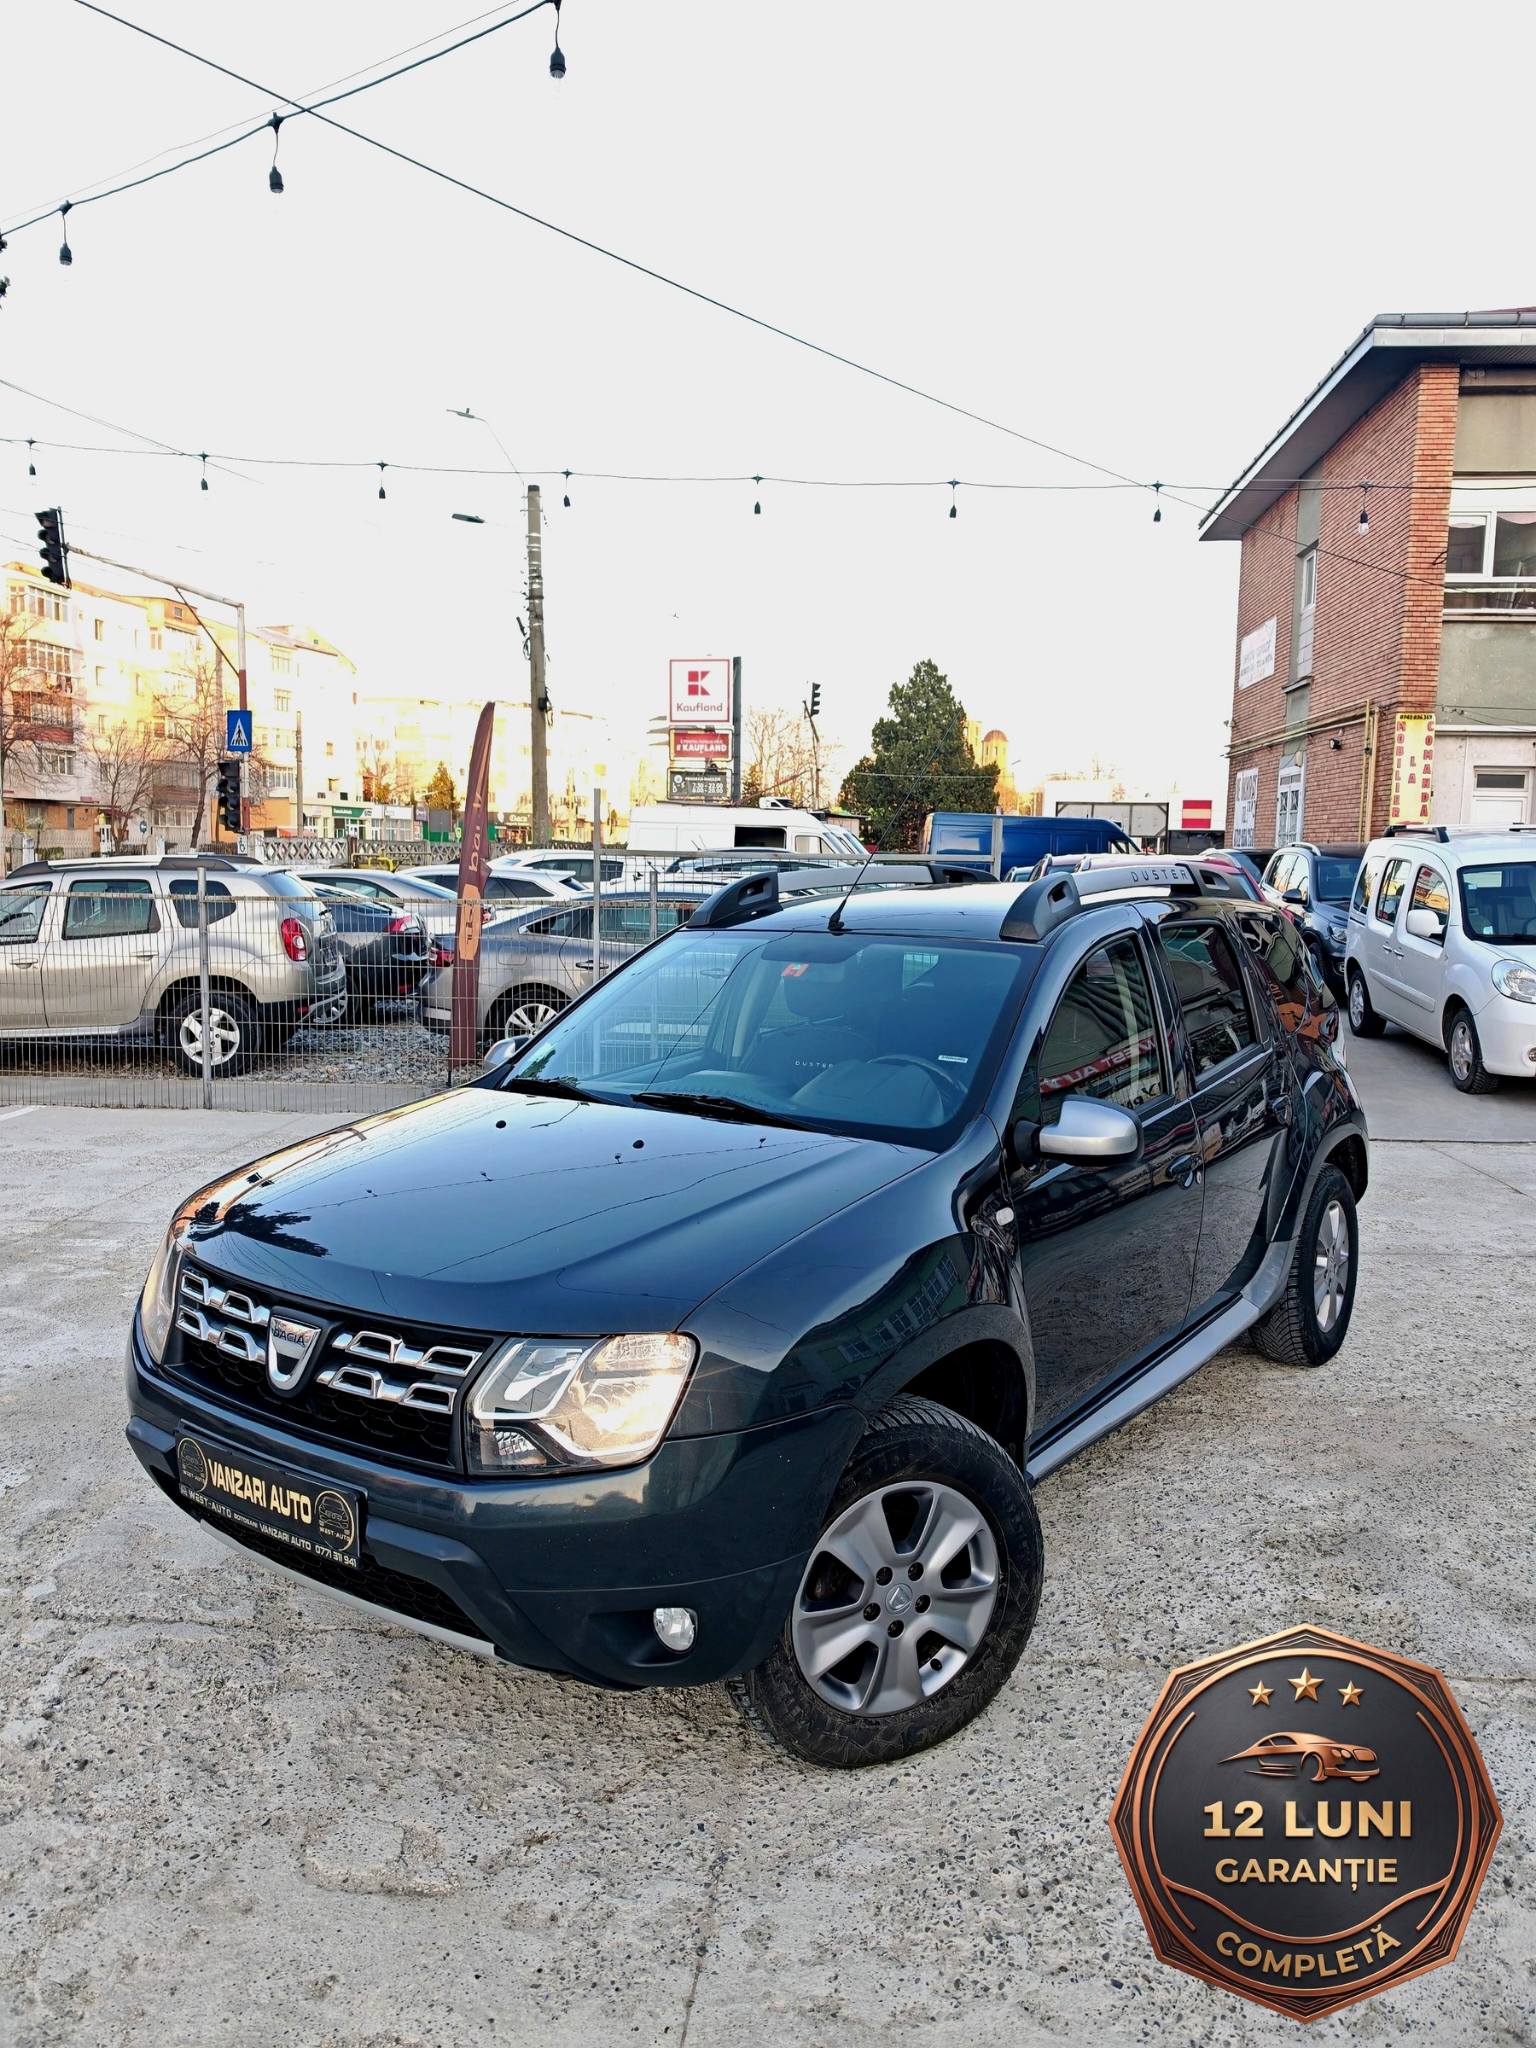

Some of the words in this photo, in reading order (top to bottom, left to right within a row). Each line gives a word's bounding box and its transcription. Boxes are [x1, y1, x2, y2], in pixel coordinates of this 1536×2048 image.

[676, 702, 723, 712] Kaufland
[682, 744, 727, 752] KAUFLAND
[1407, 756, 1417, 784] LA
[1130, 869, 1189, 882] DUSTER
[272, 1328, 306, 1347] DACIA
[208, 1458, 265, 1508] VANZARI
[270, 1484, 313, 1525] AUTO
[189, 1490, 232, 1519] WEST-AUTO
[259, 1522, 290, 1542] VANZARI
[290, 1535, 312, 1551] AUTO
[314, 1545, 332, 1561] 0771
